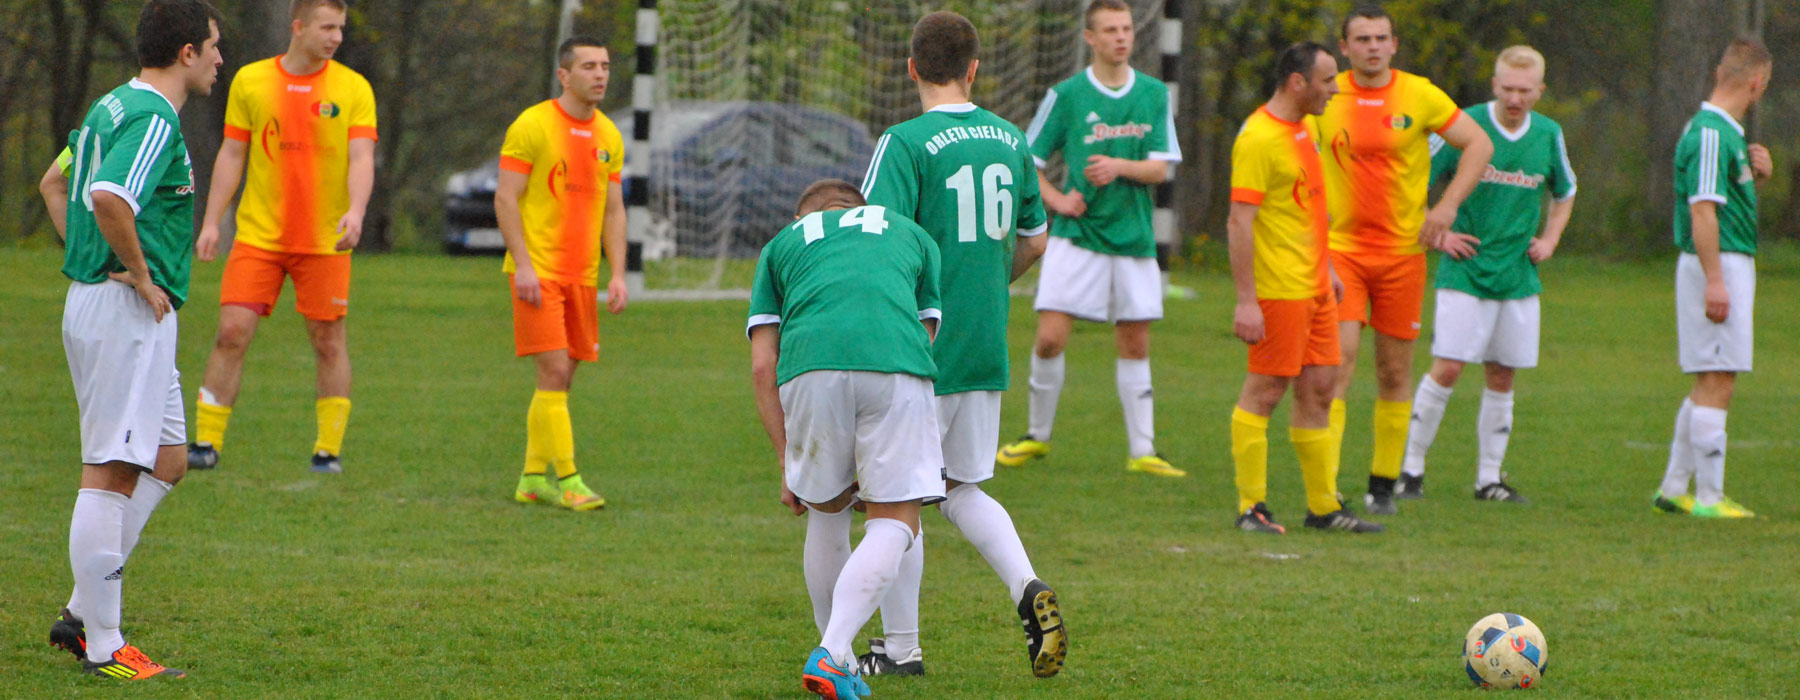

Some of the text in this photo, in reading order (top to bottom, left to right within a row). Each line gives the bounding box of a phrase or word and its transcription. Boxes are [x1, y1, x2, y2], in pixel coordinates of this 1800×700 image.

[925, 125, 1019, 156] ORLĘTA CIELĄDZ
[946, 163, 1013, 243] 16
[792, 205, 889, 246] 14
